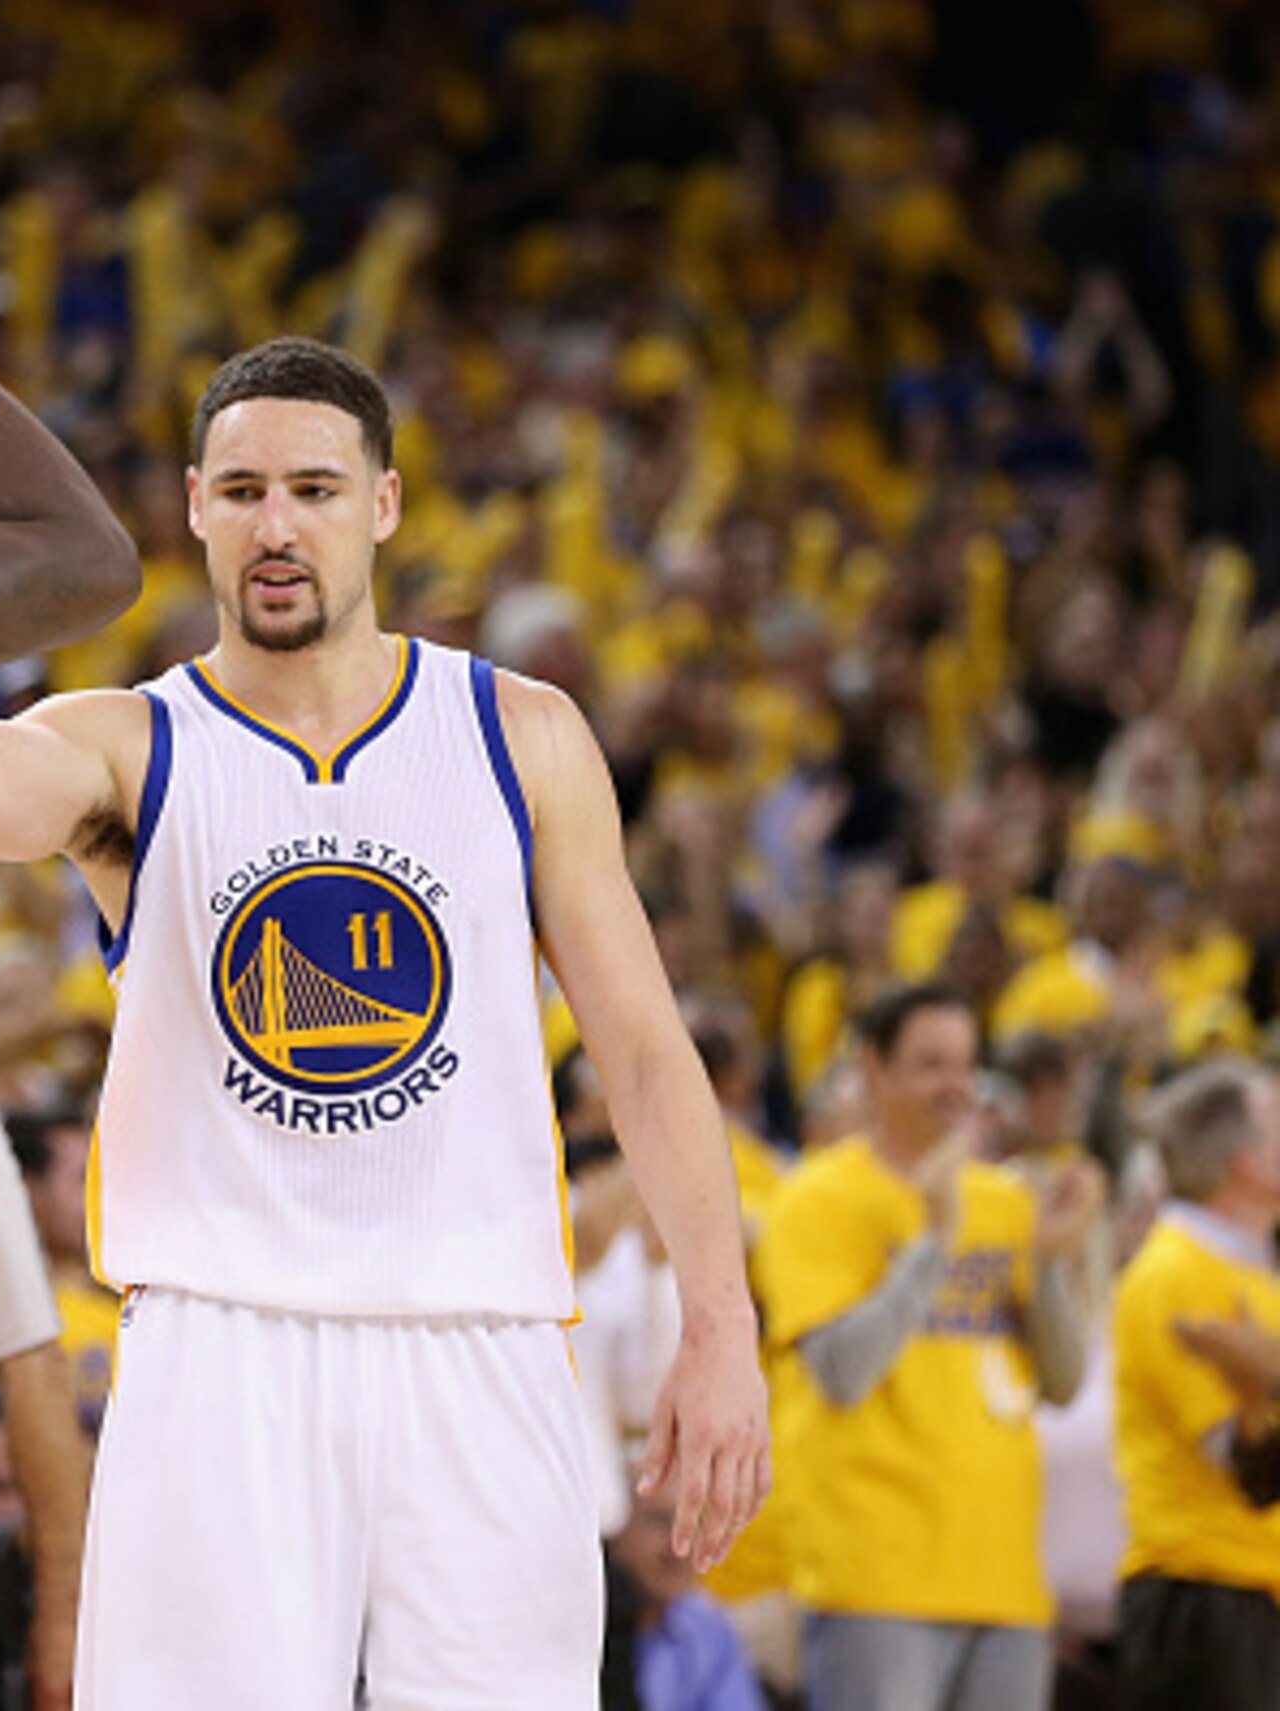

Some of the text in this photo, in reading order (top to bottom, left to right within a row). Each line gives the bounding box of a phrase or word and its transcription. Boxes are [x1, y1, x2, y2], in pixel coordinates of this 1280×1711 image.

[210, 836, 449, 914] GOLDEN STATE
[346, 911, 394, 970] 11
[223, 1045, 459, 1134] WARRIORS
